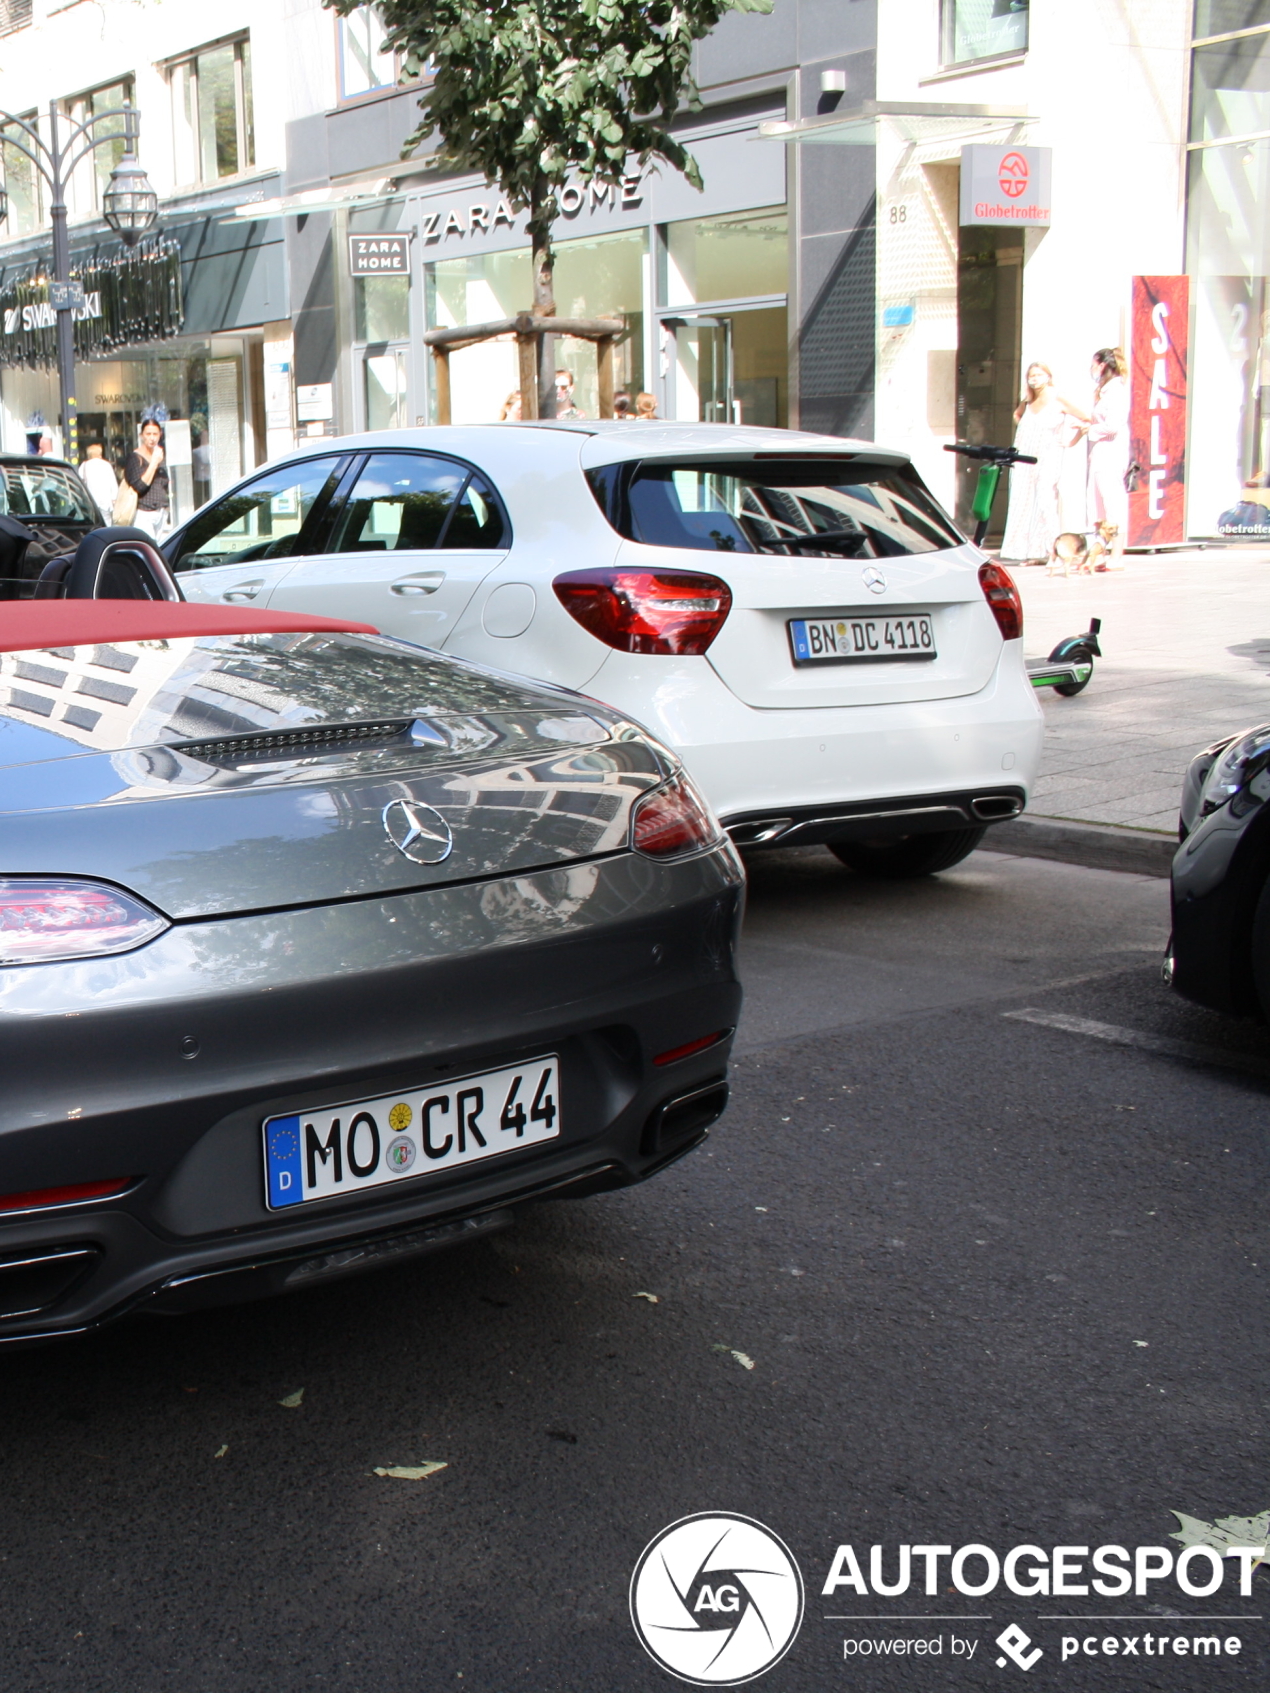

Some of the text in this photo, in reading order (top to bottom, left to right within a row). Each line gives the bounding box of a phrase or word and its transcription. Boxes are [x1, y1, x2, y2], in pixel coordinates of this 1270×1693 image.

[422, 172, 642, 239] ZARA OME
[890, 205, 907, 225] 88
[975, 203, 1050, 220] Globetrotter
[359, 242, 401, 254] ZARA
[359, 257, 402, 269] HOME
[1148, 302, 1172, 521] SALE
[809, 620, 932, 654] BN DC 4118
[799, 643, 806, 653] D
[304, 1111, 381, 1189] MO
[421, 1086, 487, 1160] CR
[500, 1068, 556, 1138] 44
[279, 1170, 292, 1191] D
